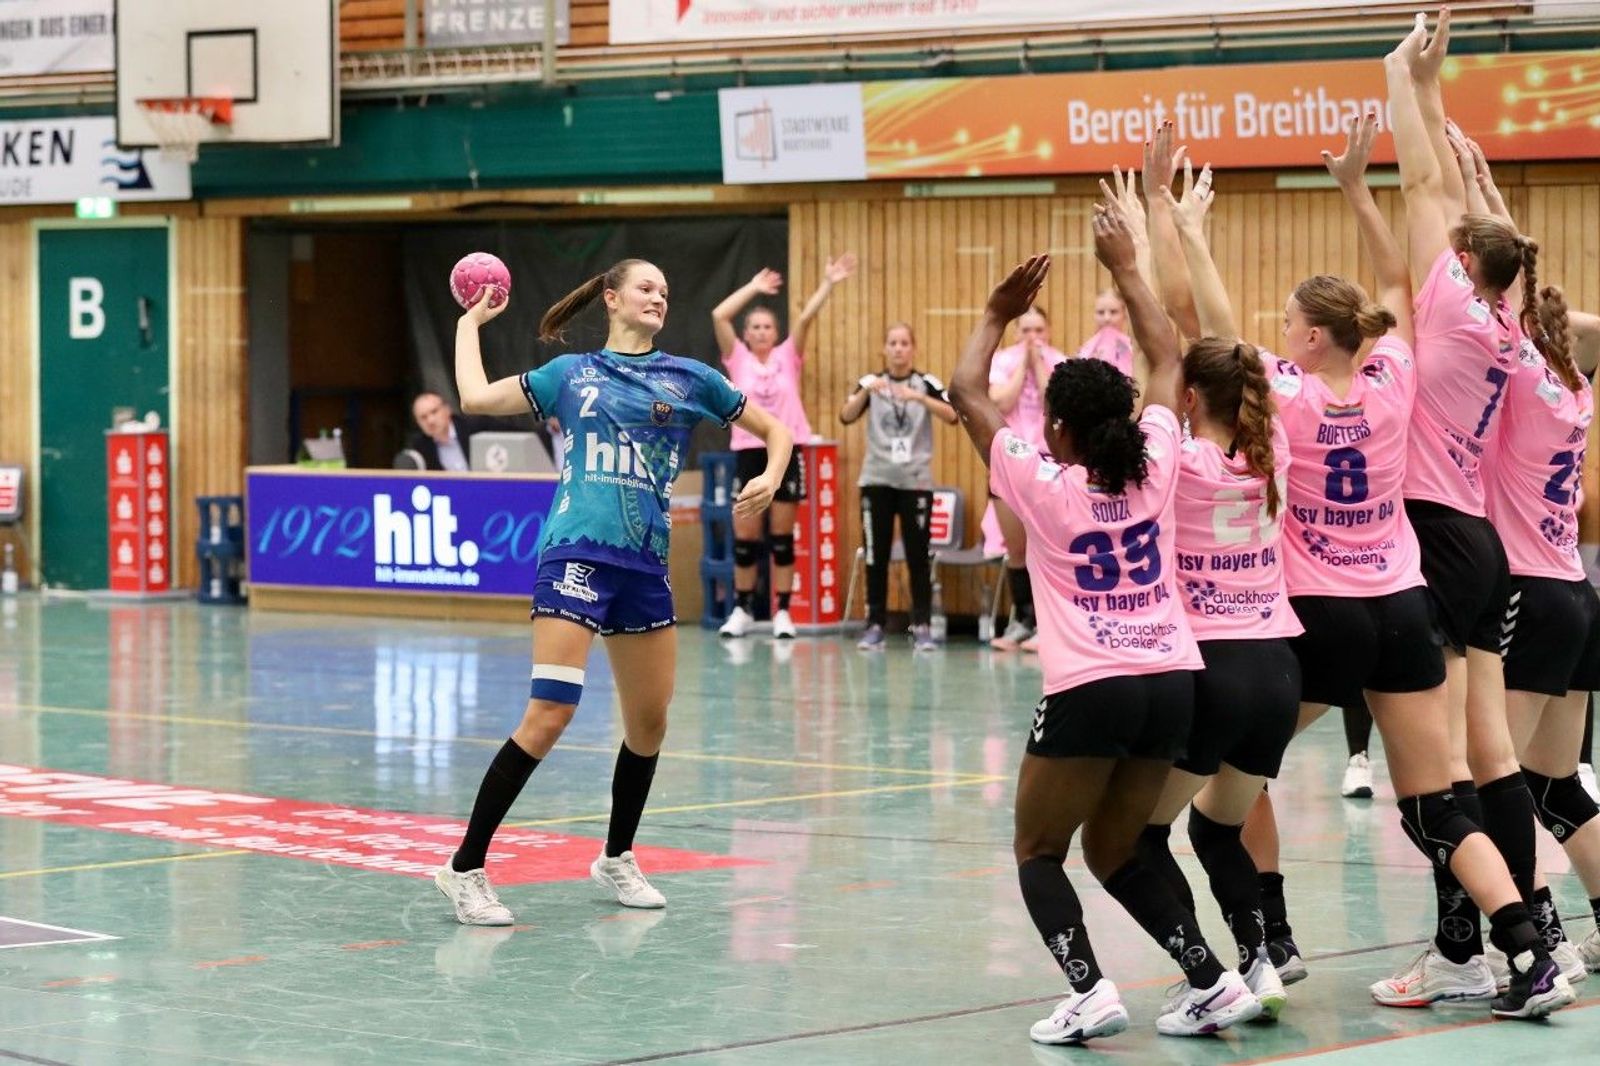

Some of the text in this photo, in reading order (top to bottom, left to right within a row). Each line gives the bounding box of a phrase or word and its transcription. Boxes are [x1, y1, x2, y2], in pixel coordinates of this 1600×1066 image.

[1067, 89, 1171, 145] Bereit
[1174, 92, 1225, 140] für
[69, 276, 105, 339] B
[579, 386, 599, 418] 2
[1474, 367, 1508, 439] 7
[896, 440, 907, 453] A
[1324, 446, 1369, 505] 8
[259, 505, 372, 558] 1972
[374, 485, 479, 567] hit.
[1292, 499, 1394, 528] tsv bayer 04
[375, 565, 480, 586] hit-immobilien.de
[1069, 519, 1162, 592] 39
[1178, 546, 1277, 572] tsv bayer 04
[1106, 591, 1151, 612] bayer
[1154, 582, 1170, 604] 04
